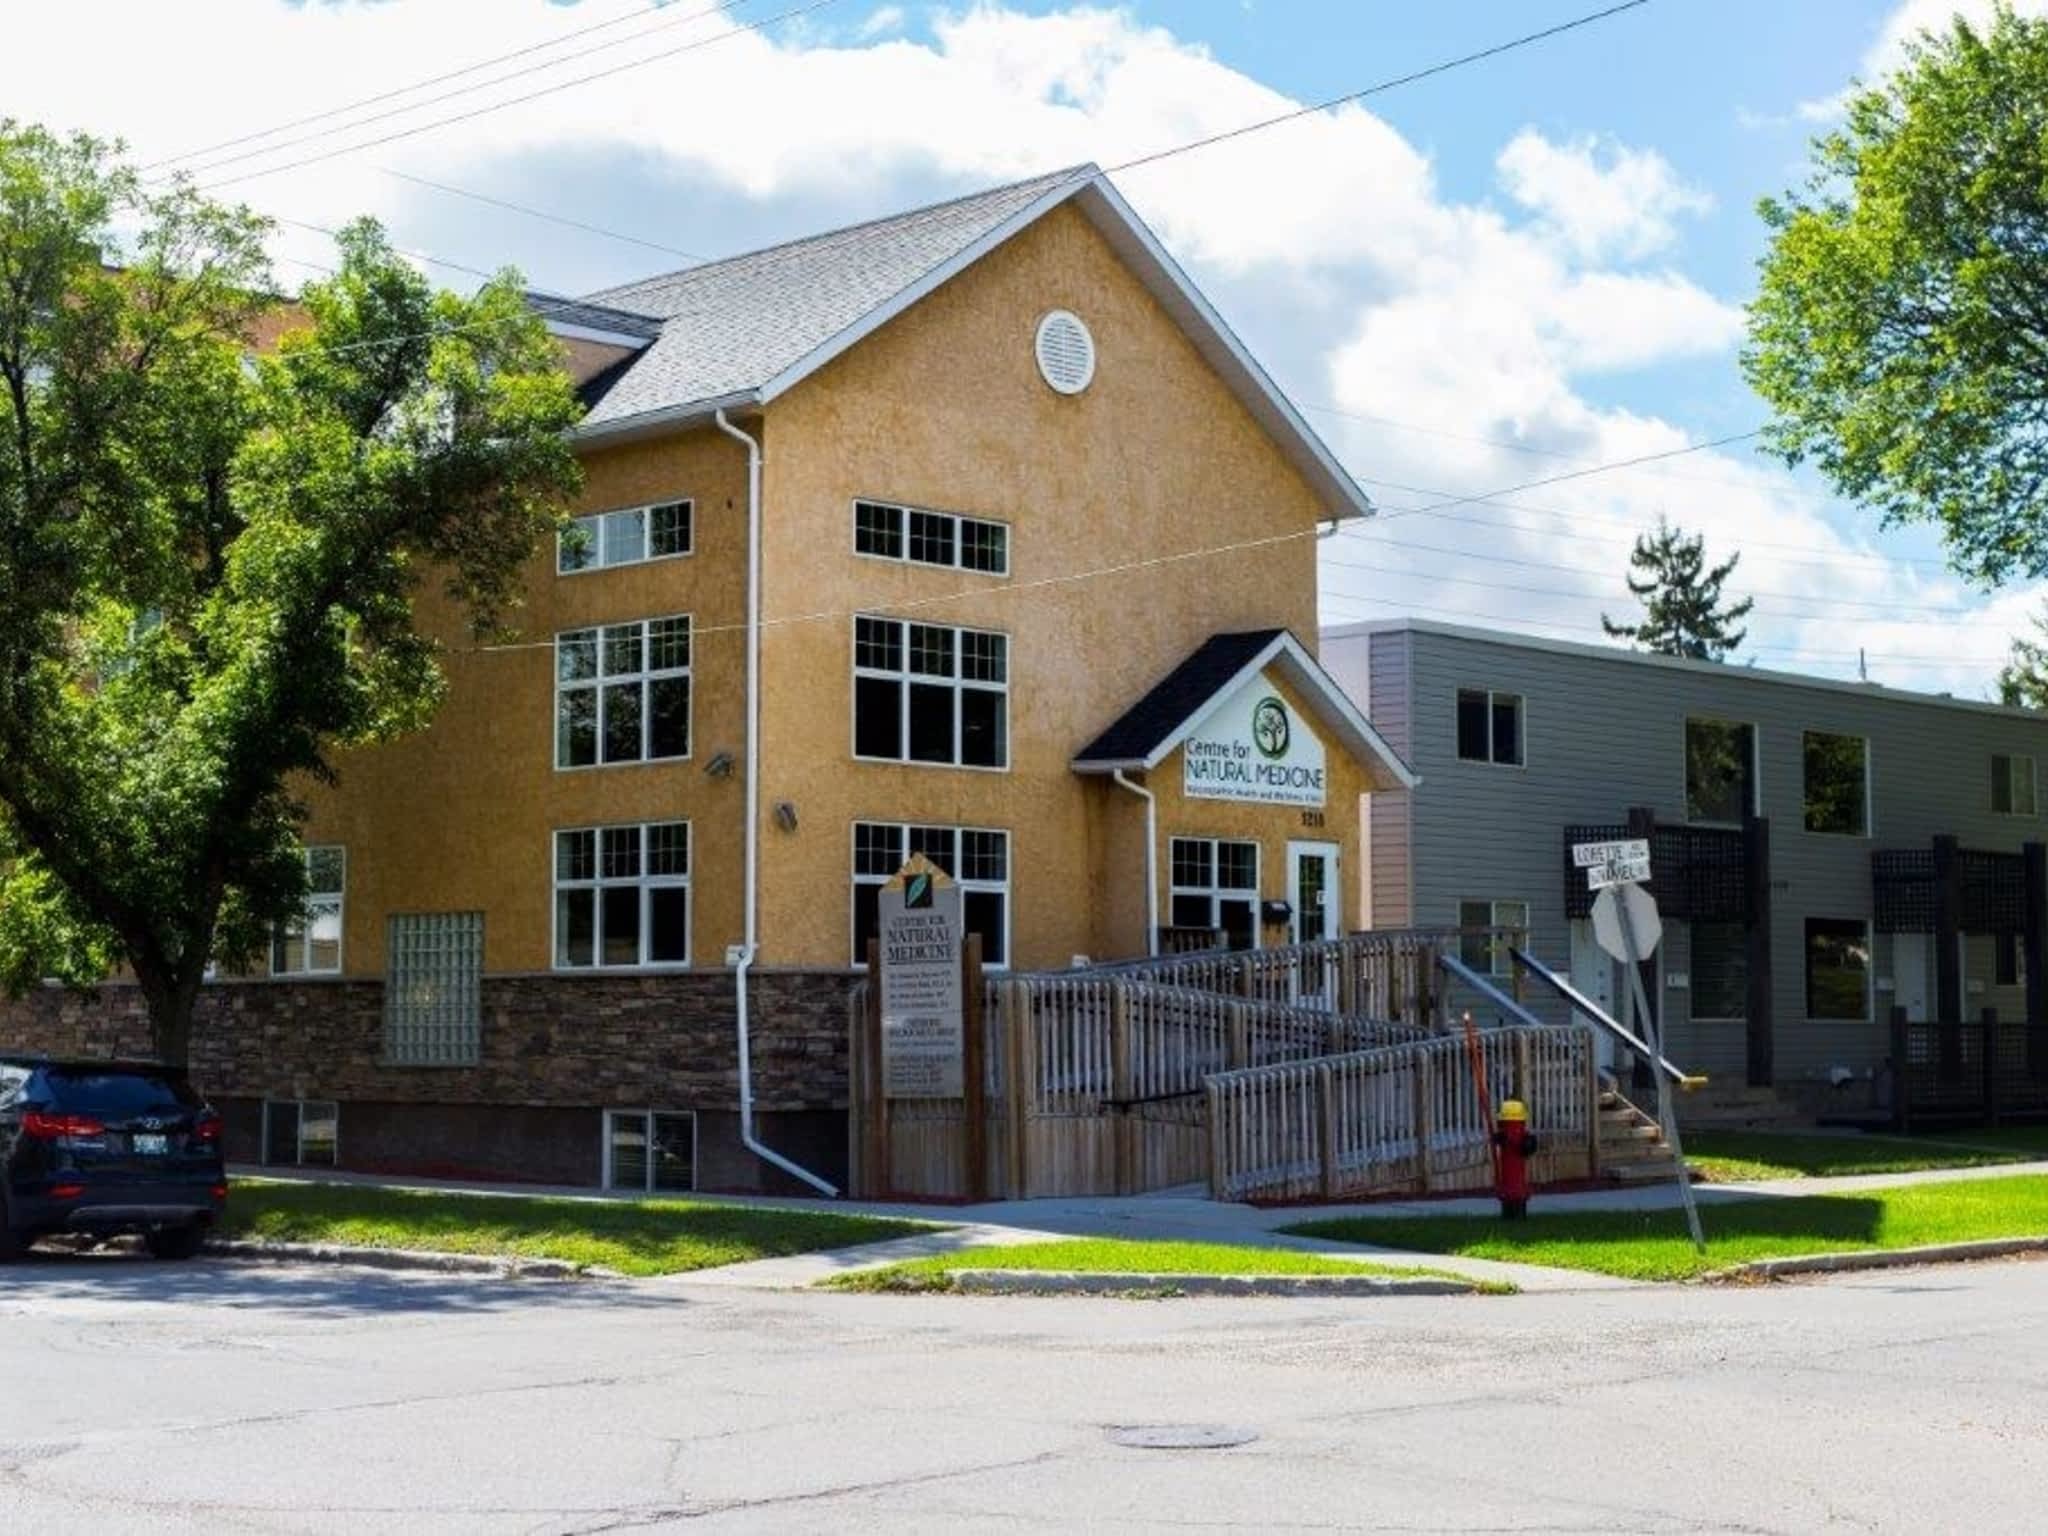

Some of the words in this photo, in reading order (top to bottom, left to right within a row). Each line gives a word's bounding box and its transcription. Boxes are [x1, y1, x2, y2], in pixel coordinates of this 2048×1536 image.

[1186, 737, 1230, 758] Centre
[1233, 740, 1250, 758] for
[1186, 759, 1252, 783] NATURAL
[1255, 764, 1324, 789] MEDICINE
[887, 927, 952, 944] NATURAL
[888, 944, 953, 961] MEDICINE
